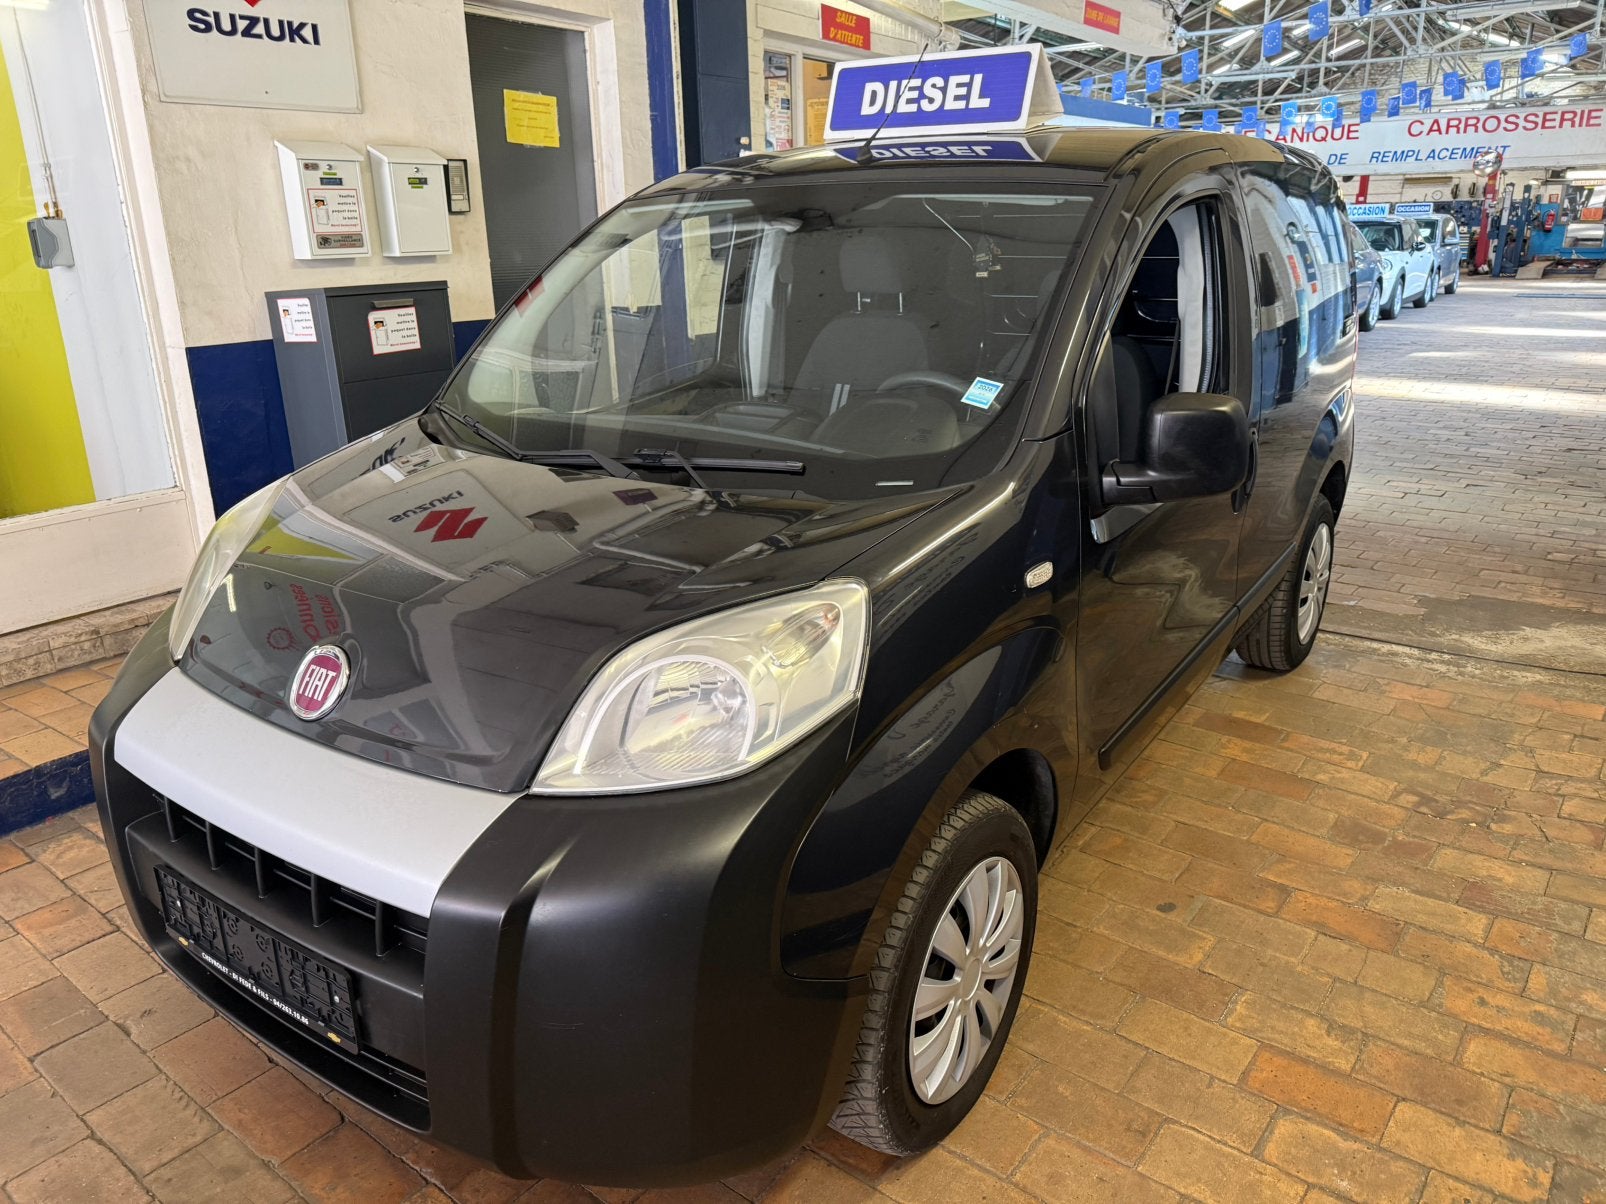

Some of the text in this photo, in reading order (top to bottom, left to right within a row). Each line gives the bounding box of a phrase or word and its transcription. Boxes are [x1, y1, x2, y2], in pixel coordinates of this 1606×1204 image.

[186, 8, 321, 46] SUZUKI
[836, 11, 856, 27] SALLE
[829, 27, 864, 47] D'ATTENTE
[861, 74, 991, 115] DIESEL
[1408, 109, 1604, 137] CARROSSERIE
[1327, 153, 1349, 165] DE
[299, 664, 337, 701] FIAT
[201, 952, 229, 974] CHEVROLET
[232, 972, 239, 981] DI
[239, 977, 252, 990] FEDE
[257, 988, 269, 1001] FILS
